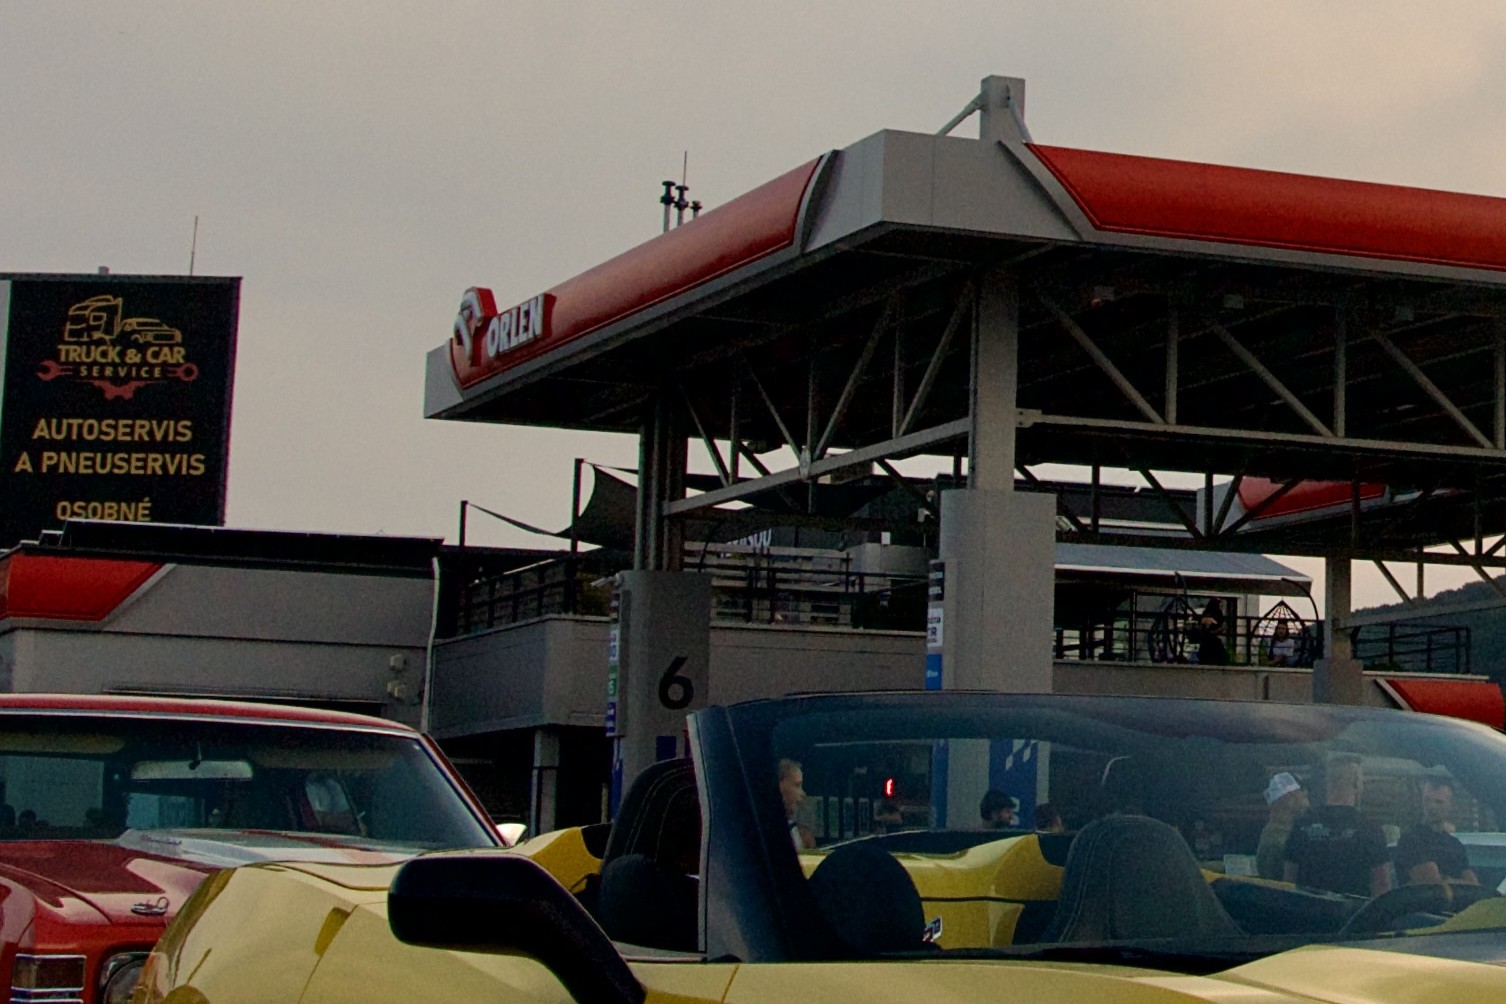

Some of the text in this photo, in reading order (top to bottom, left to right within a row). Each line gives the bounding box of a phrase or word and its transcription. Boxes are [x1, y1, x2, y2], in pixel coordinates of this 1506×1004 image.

[486, 293, 546, 358] ORLEN
[57, 345, 188, 364] TRUCK & CAR
[79, 366, 163, 378] SERVICE
[31, 417, 194, 443] AUTOSERVIS
[14, 451, 207, 476] A PNEUSERVIS
[56, 497, 152, 521] OSOBNÉ
[658, 656, 694, 710] 6
